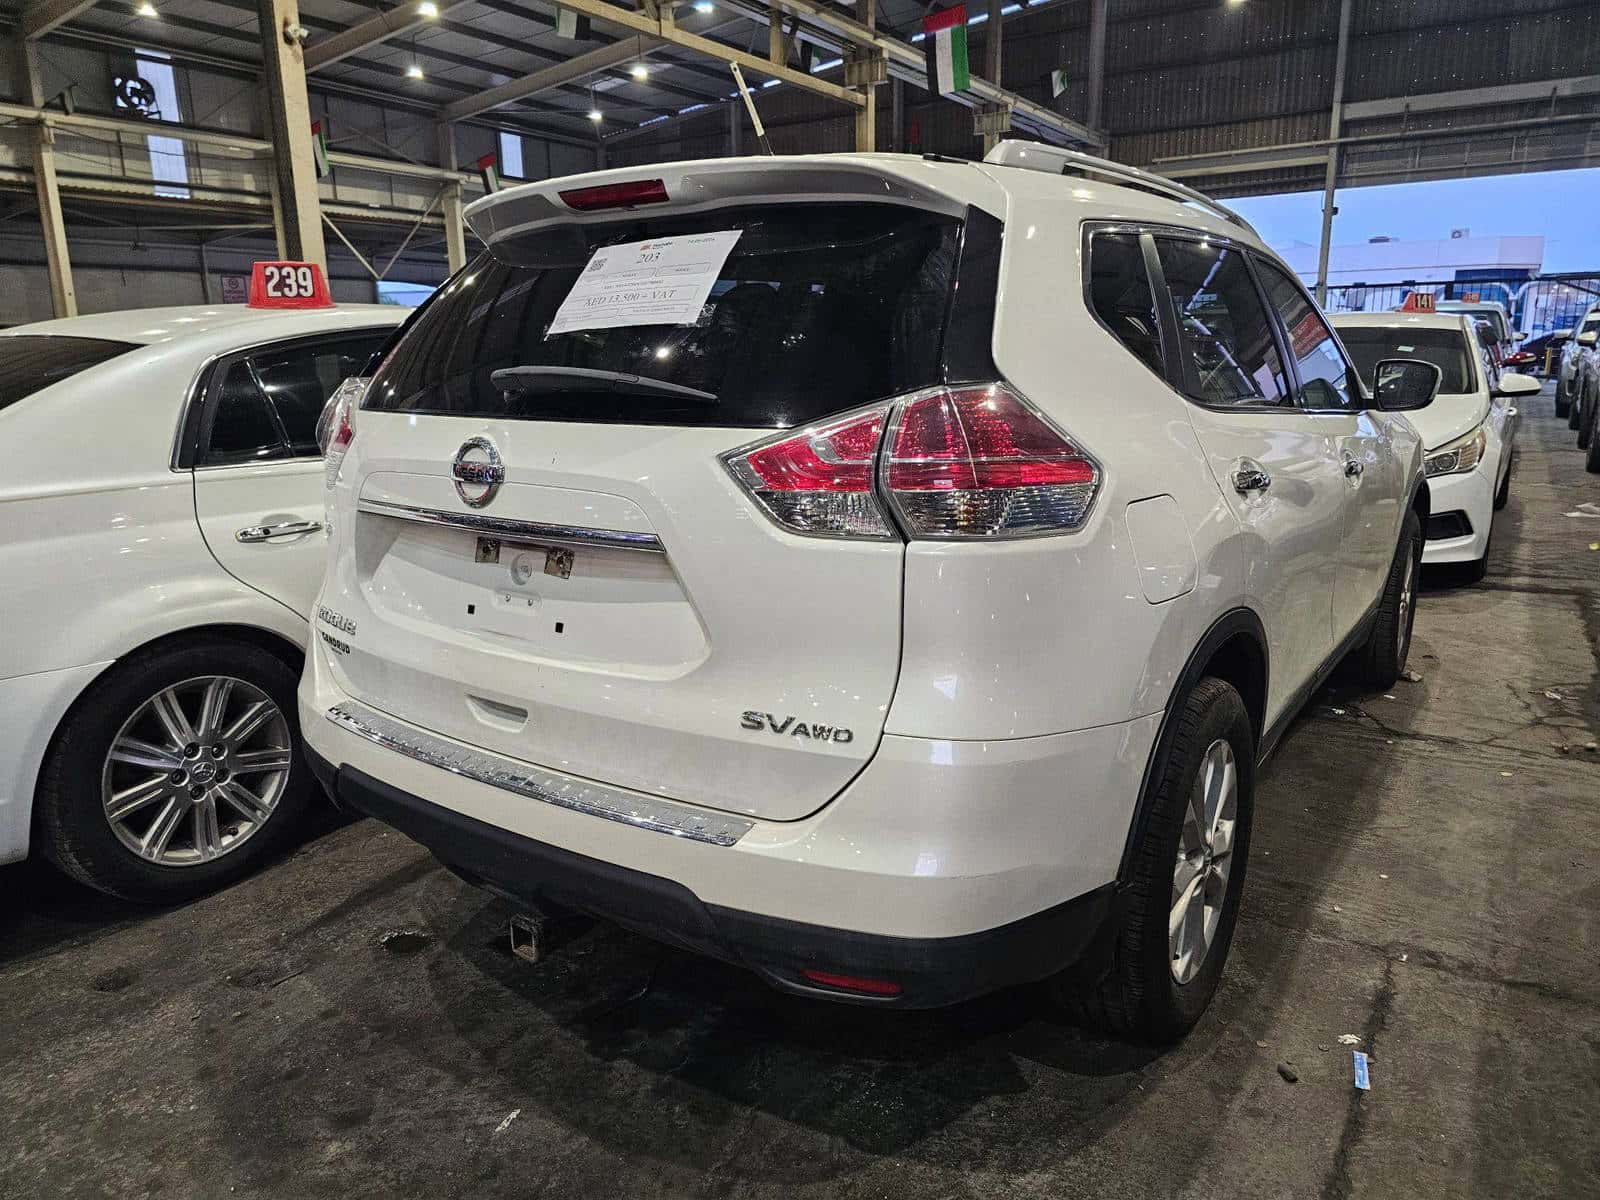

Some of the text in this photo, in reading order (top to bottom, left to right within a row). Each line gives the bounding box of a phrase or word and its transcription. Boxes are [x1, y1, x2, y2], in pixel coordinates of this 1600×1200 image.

[265, 266, 313, 297] 239
[652, 289, 677, 299] VAT
[1417, 294, 1433, 308] 141
